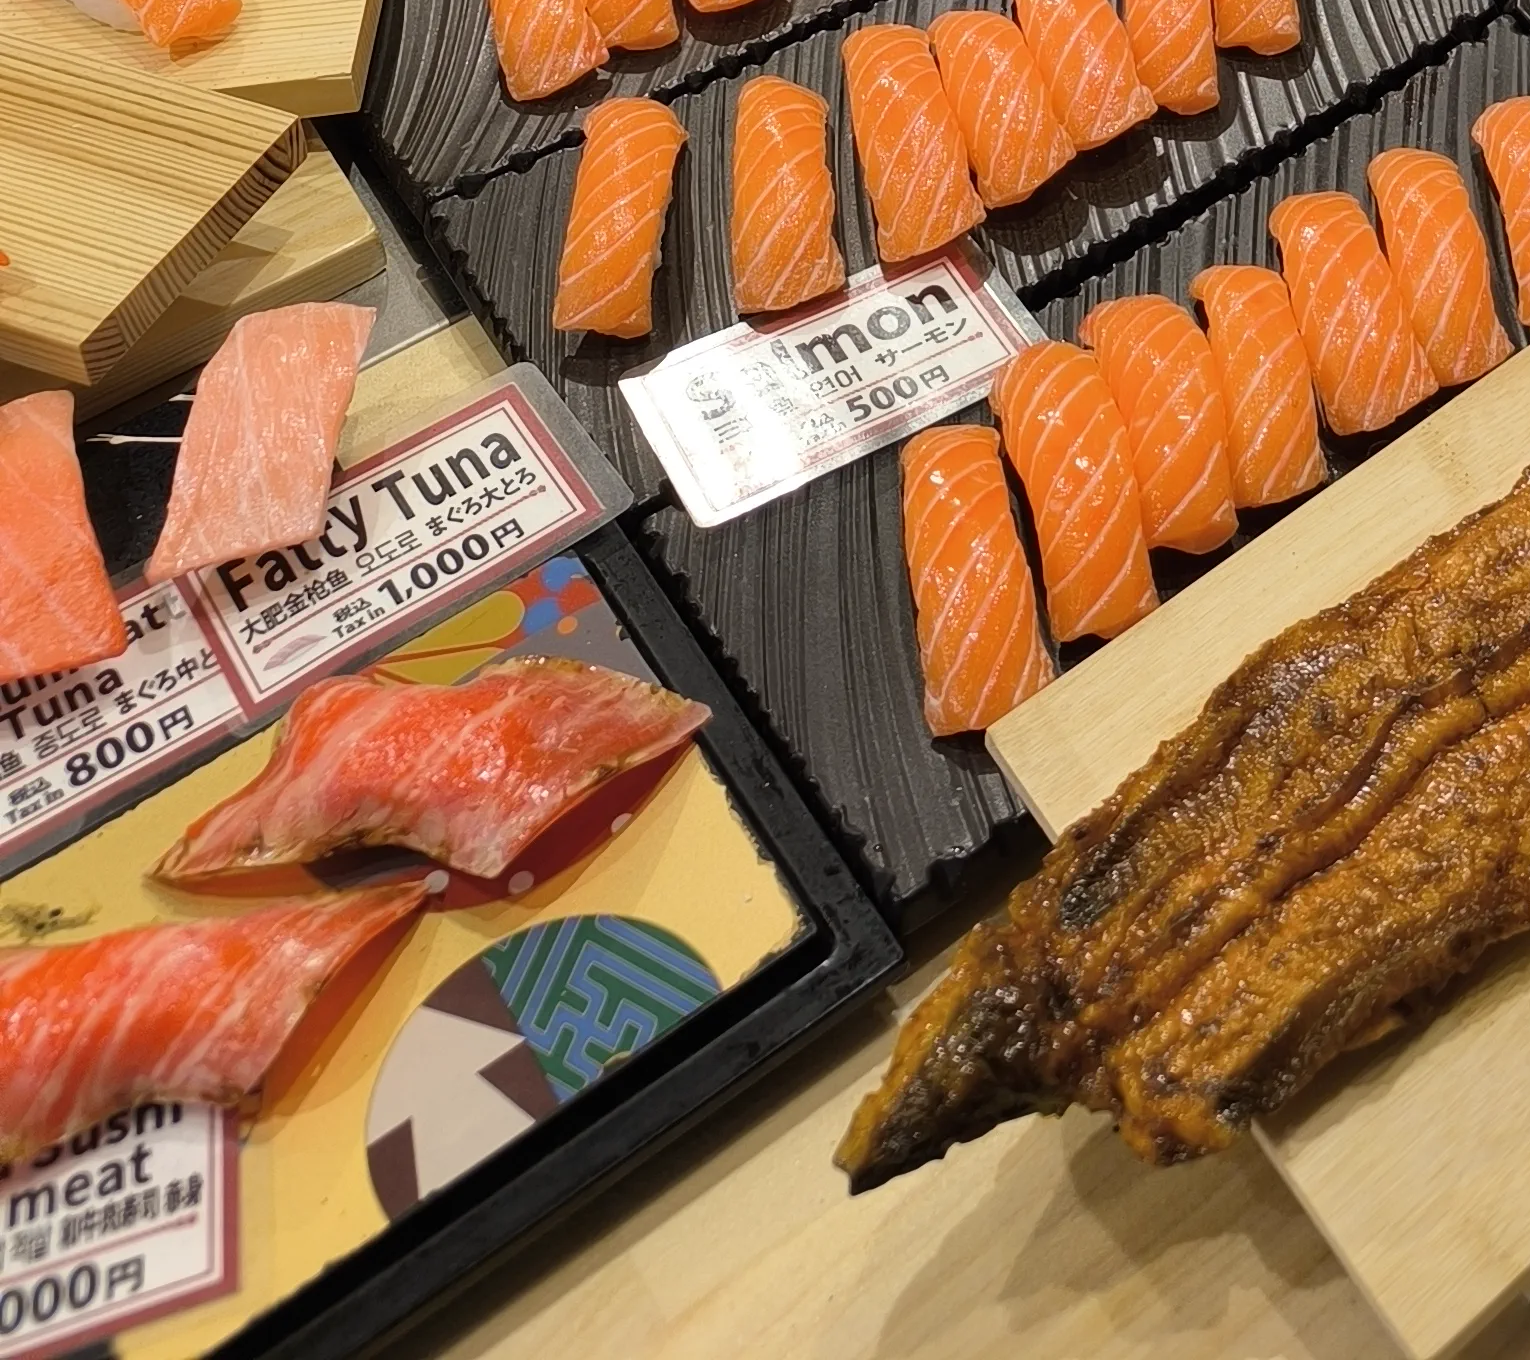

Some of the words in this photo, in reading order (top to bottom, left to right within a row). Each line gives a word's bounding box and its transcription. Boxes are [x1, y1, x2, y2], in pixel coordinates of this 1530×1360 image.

[874, 316, 968, 368] サーモン
[809, 364, 863, 399] 연어
[846, 364, 950, 423] 500円
[371, 432, 522, 521] Tuna
[424, 466, 538, 537] まぐろ大とろ
[355, 529, 423, 578] 오도로
[377, 518, 526, 606] 1,000円
[332, 615, 367, 640] Tax
[367, 605, 386, 627] in
[333, 597, 373, 623] 税込
[0, 667, 124, 740] Tuna
[31, 706, 108, 761] 중도로
[65, 704, 195, 788] 800円
[3, 799, 45, 825] Tax
[45, 787, 66, 806] in
[9, 1143, 152, 1228] meat
